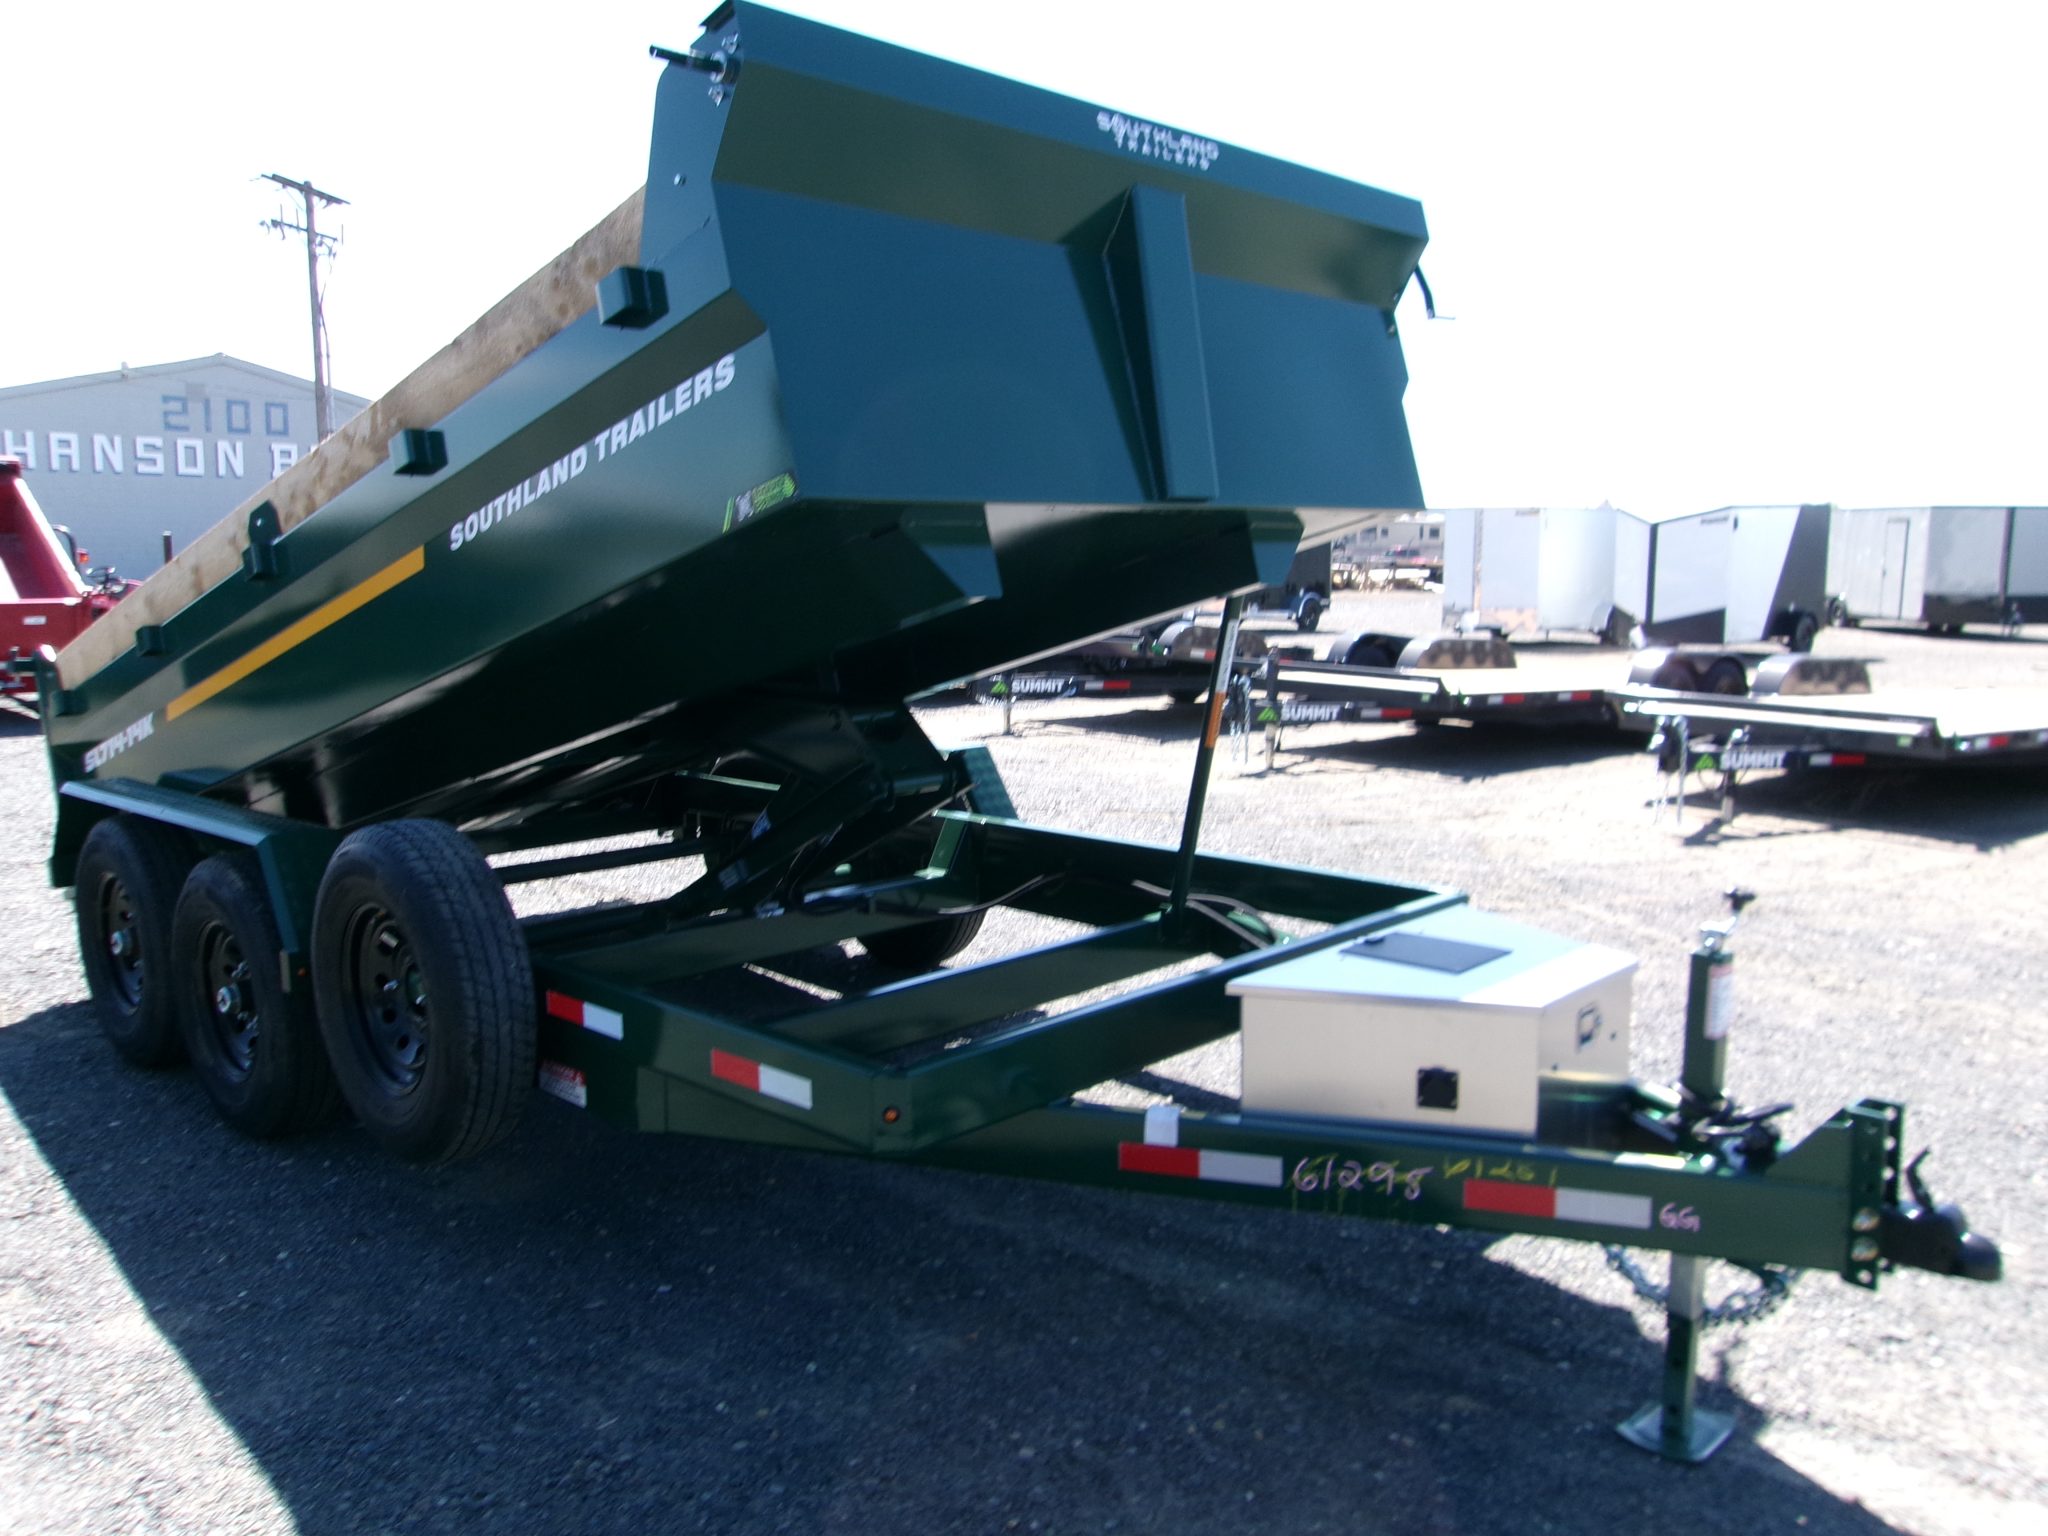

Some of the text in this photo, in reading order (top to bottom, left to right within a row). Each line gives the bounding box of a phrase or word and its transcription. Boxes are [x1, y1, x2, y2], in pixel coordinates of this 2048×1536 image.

[1097, 110, 1220, 161] SOUTHLAND
[161, 393, 289, 437] 2100
[3, 428, 245, 479] HANSON
[449, 353, 736, 551] SOUTHLAND TRAILERS
[1011, 677, 1065, 694] SUMMIT
[1280, 703, 1342, 723] SUMMIT
[1719, 749, 1787, 771] SUMMIT
